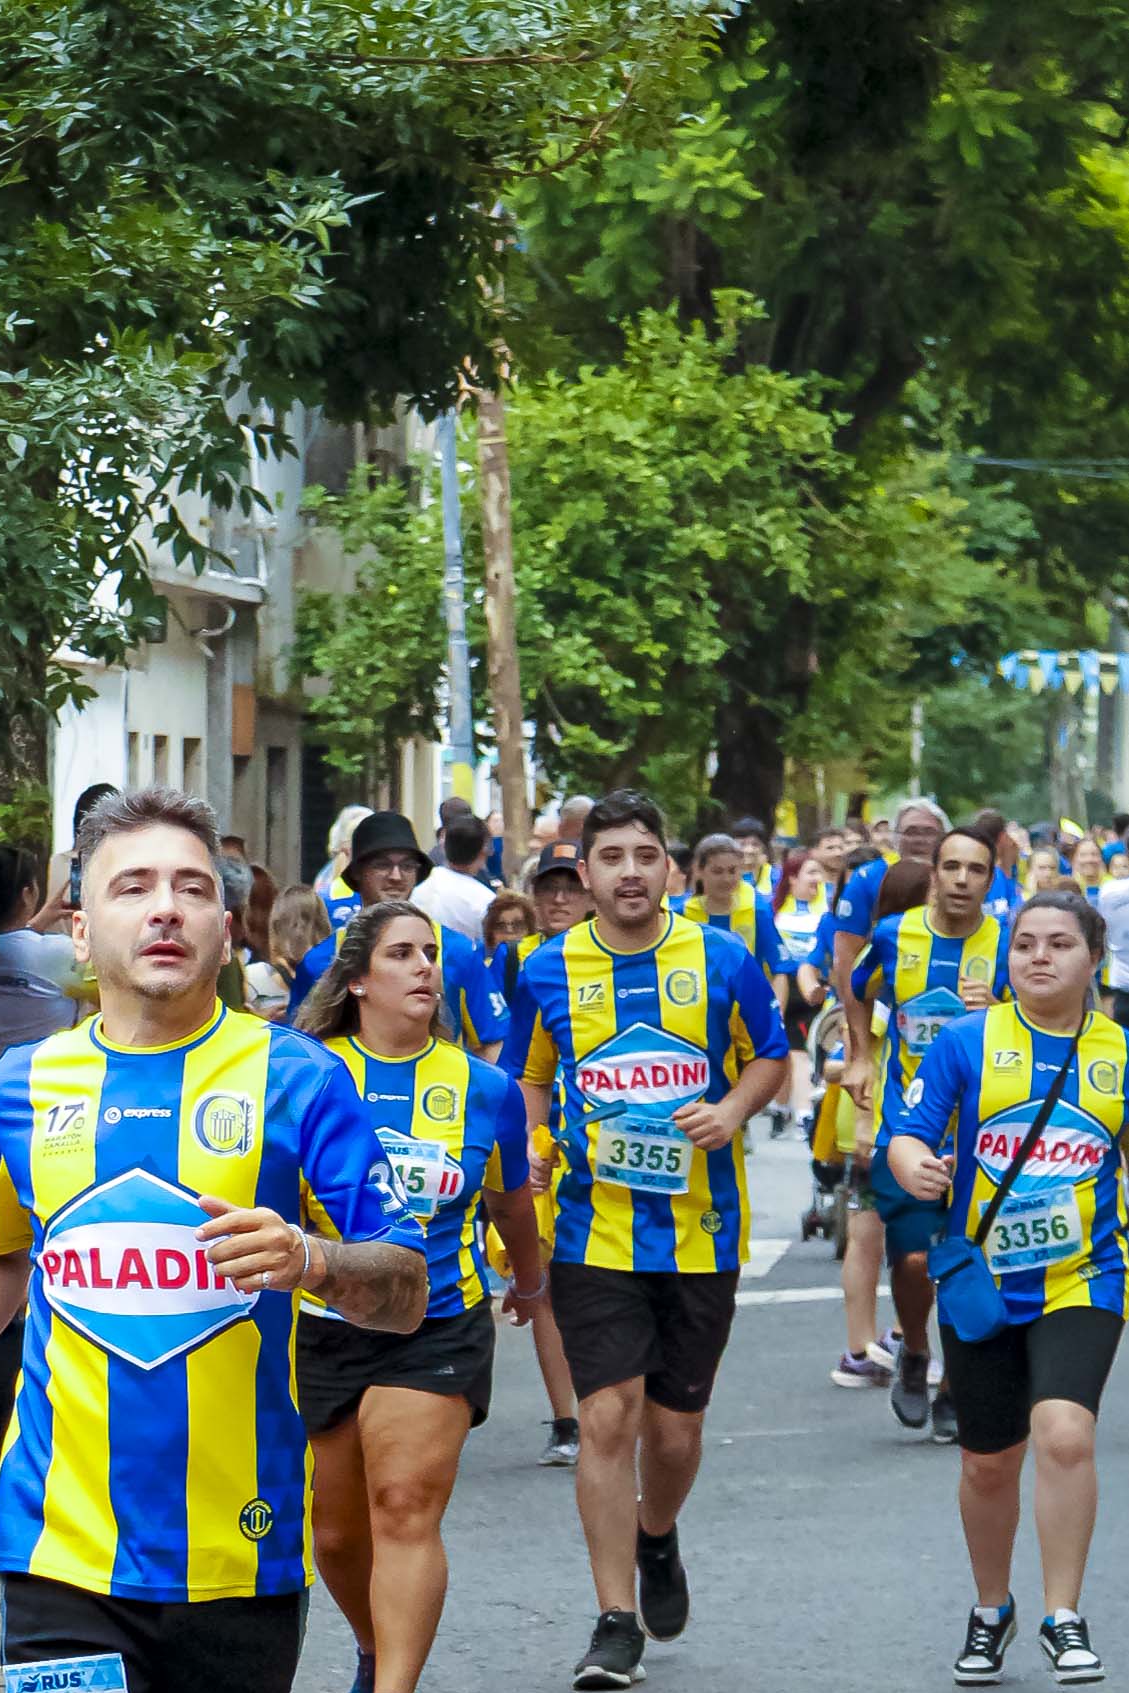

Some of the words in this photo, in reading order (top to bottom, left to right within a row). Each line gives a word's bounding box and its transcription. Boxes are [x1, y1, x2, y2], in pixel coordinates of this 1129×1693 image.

[580, 1061, 707, 1092] PALADINI
[122, 1106, 173, 1119] express
[610, 1139, 682, 1173] 3355
[994, 1214, 1069, 1251] 3356
[41, 1671, 82, 1690] RUS
